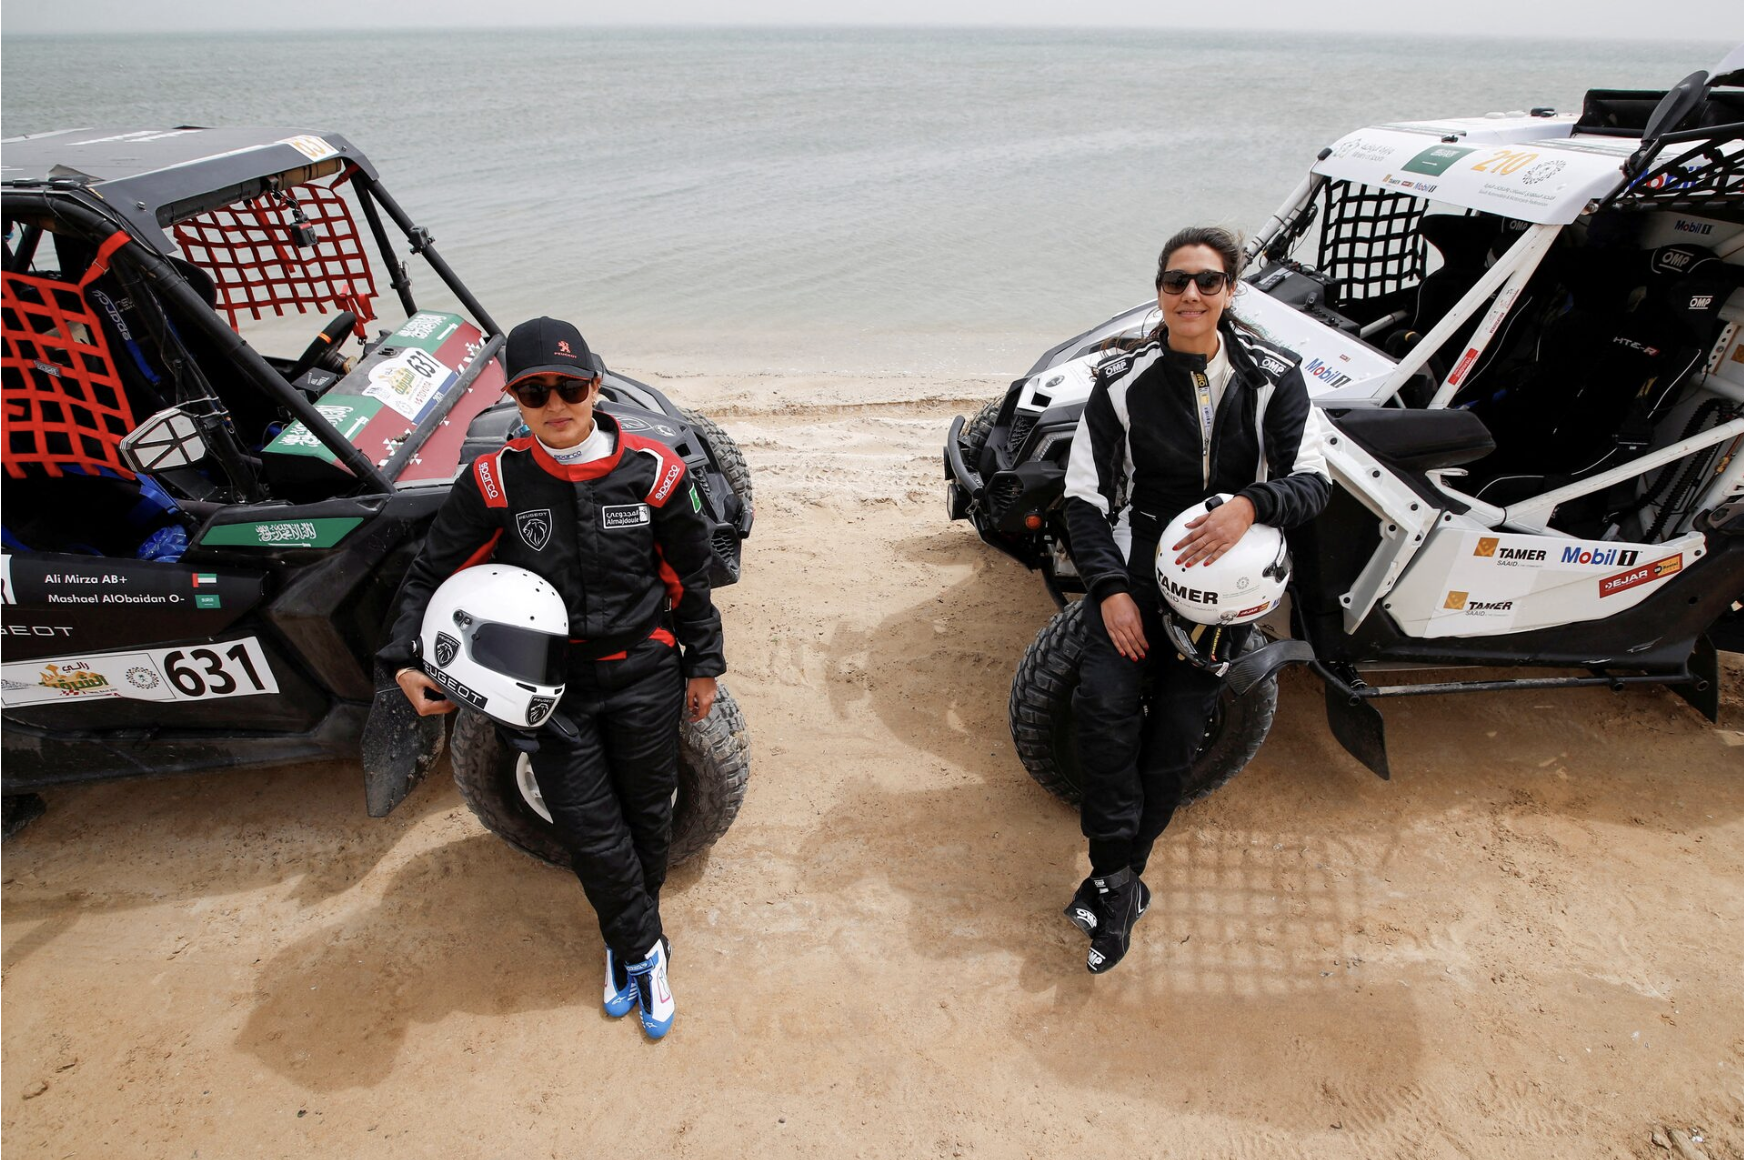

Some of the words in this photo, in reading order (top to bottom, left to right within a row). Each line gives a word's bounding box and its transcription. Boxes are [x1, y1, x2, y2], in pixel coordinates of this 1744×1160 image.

[1470, 150, 1539, 176] 210
[1509, 220, 1529, 230] OMP
[1674, 220, 1702, 234] Mobil
[1661, 251, 1690, 267] OMP
[1689, 298, 1711, 307] OMP
[1612, 336, 1658, 356] HTE-R
[406, 350, 440, 378] 631
[1105, 361, 1127, 374] OMP
[1261, 358, 1285, 374] OMP
[1305, 358, 1341, 384] Mobil
[479, 461, 499, 500] sparco
[655, 464, 680, 501] sparco
[518, 512, 548, 520] PEUGEOT
[1499, 547, 1547, 561] TAMER
[1560, 546, 1617, 566] Mobil
[44, 574, 61, 584] Ali
[64, 574, 99, 584] Mirza
[101, 574, 128, 584] AB+
[1157, 567, 1218, 605] TAMER
[48, 594, 99, 603] Mashael
[102, 594, 166, 603] AlObaidan
[169, 594, 185, 603] O-
[1468, 601, 1513, 611] TAMER
[62, 661, 90, 673] رالي
[163, 643, 266, 697] 631
[1088, 950, 1103, 966] MP
